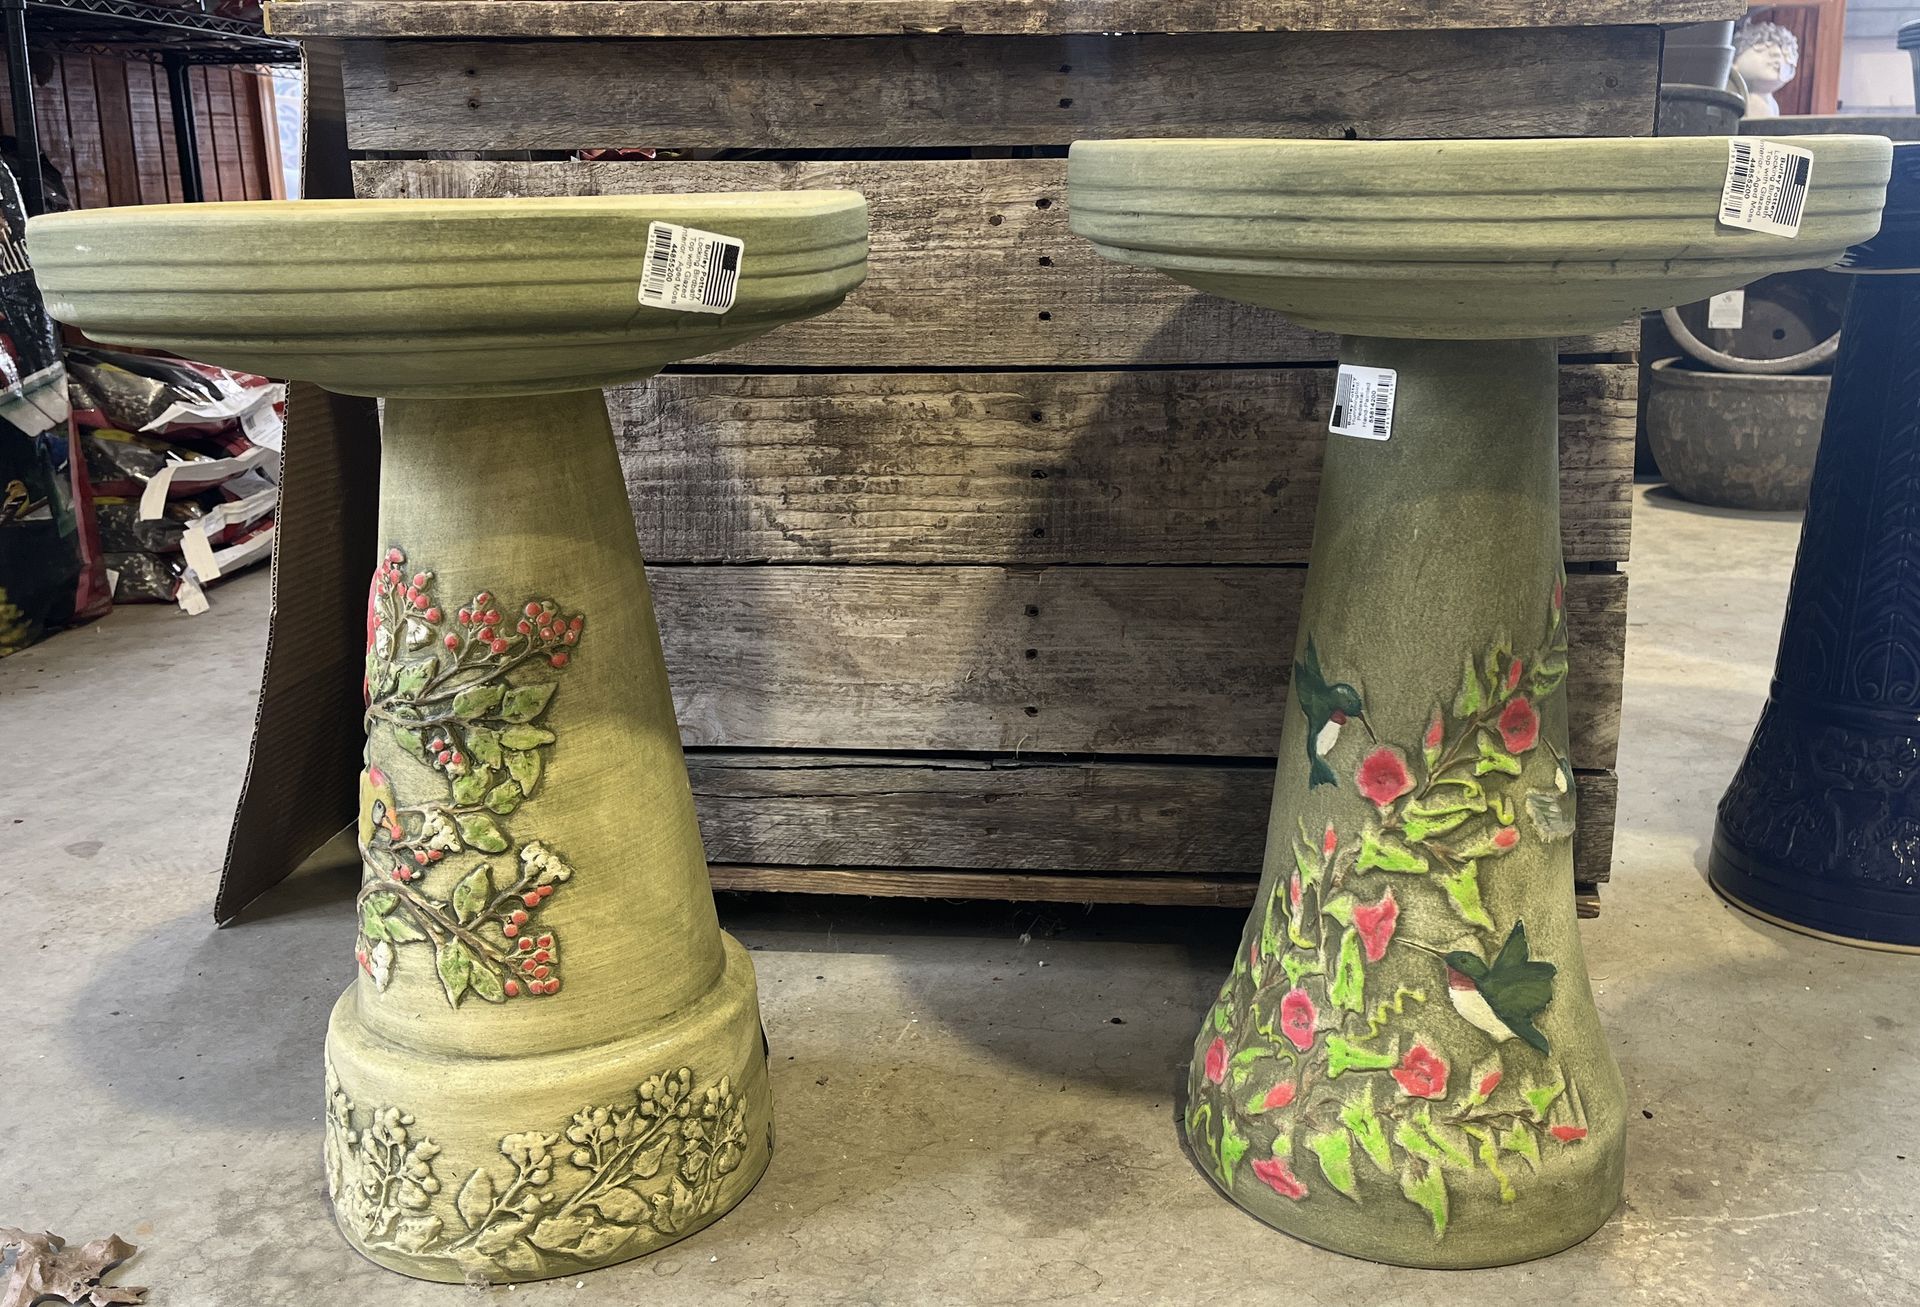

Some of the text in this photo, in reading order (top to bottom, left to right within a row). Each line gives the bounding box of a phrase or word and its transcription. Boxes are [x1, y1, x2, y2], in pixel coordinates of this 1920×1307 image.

[1744, 158, 1756, 200] 44855200
[1753, 176, 1761, 198] Aged
[1762, 150, 1780, 219] Locking Birdbath
[1768, 157, 1786, 219] Burley Pottery
[1756, 186, 1767, 216] Glazed
[666, 243, 678, 283] 44855200
[675, 261, 683, 282] Aged
[689, 237, 704, 301] Locking Birdbath
[695, 244, 711, 302] Burley Pottery
[681, 271, 691, 298] Glazed
